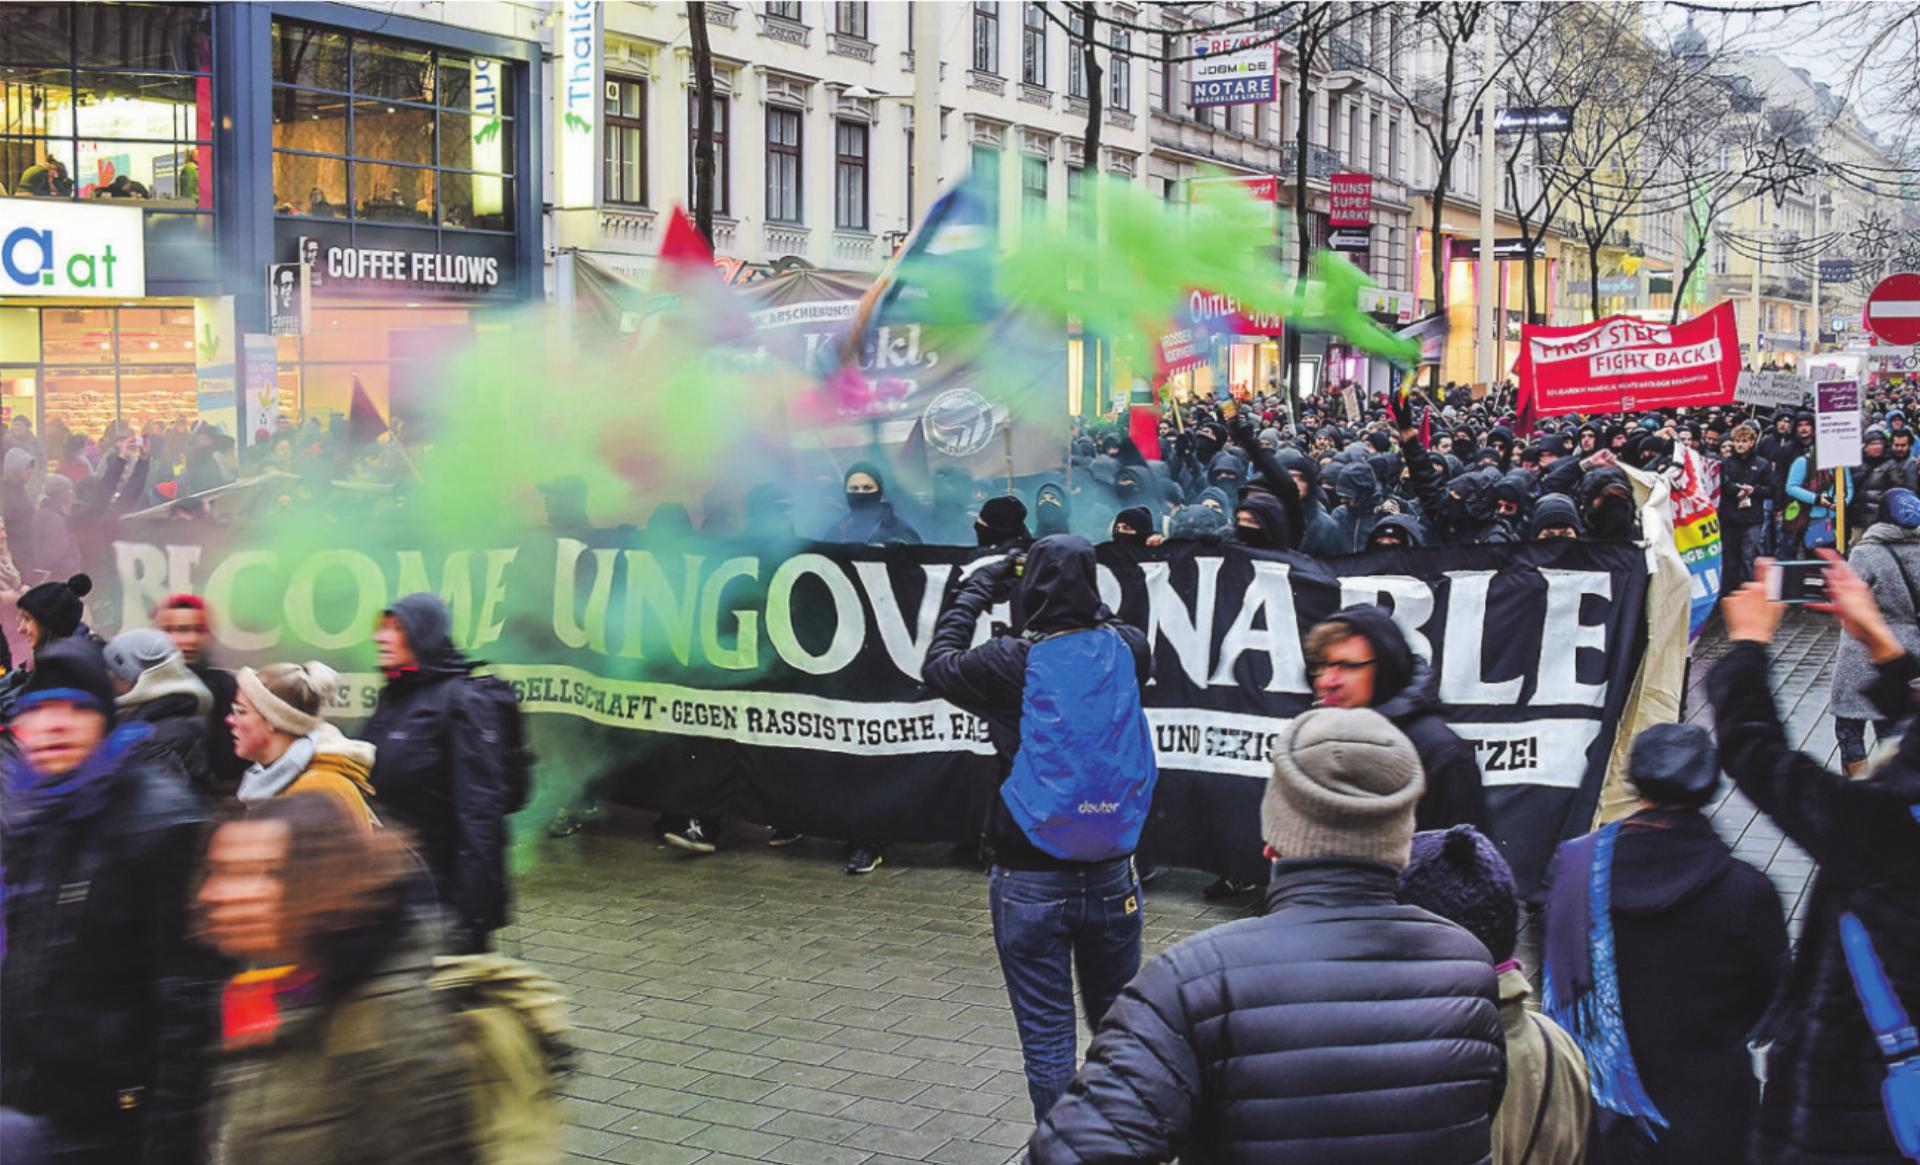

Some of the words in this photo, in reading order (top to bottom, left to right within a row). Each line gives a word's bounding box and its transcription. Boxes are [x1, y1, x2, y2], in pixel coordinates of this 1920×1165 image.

[1194, 79, 1271, 96] NOTARE
[1332, 183, 1370, 194] KUNST
[328, 248, 406, 280] COFFEE
[412, 255, 499, 286] FELLOWS
[1541, 331, 1602, 359] FIRST
[1608, 324, 1661, 345] STEP
[1595, 353, 1648, 372] FIGHT
[552, 538, 1614, 707] UNGOVNABLE
[510, 676, 657, 720] SELLSCHAFT
[671, 699, 738, 730] GEGEN
[746, 706, 945, 747] RASSISTISCHE,
[950, 713, 991, 743] FAS
[1156, 724, 1201, 753] UND
[1472, 737, 1538, 769] TZE!
[1078, 800, 1120, 815] deuter
